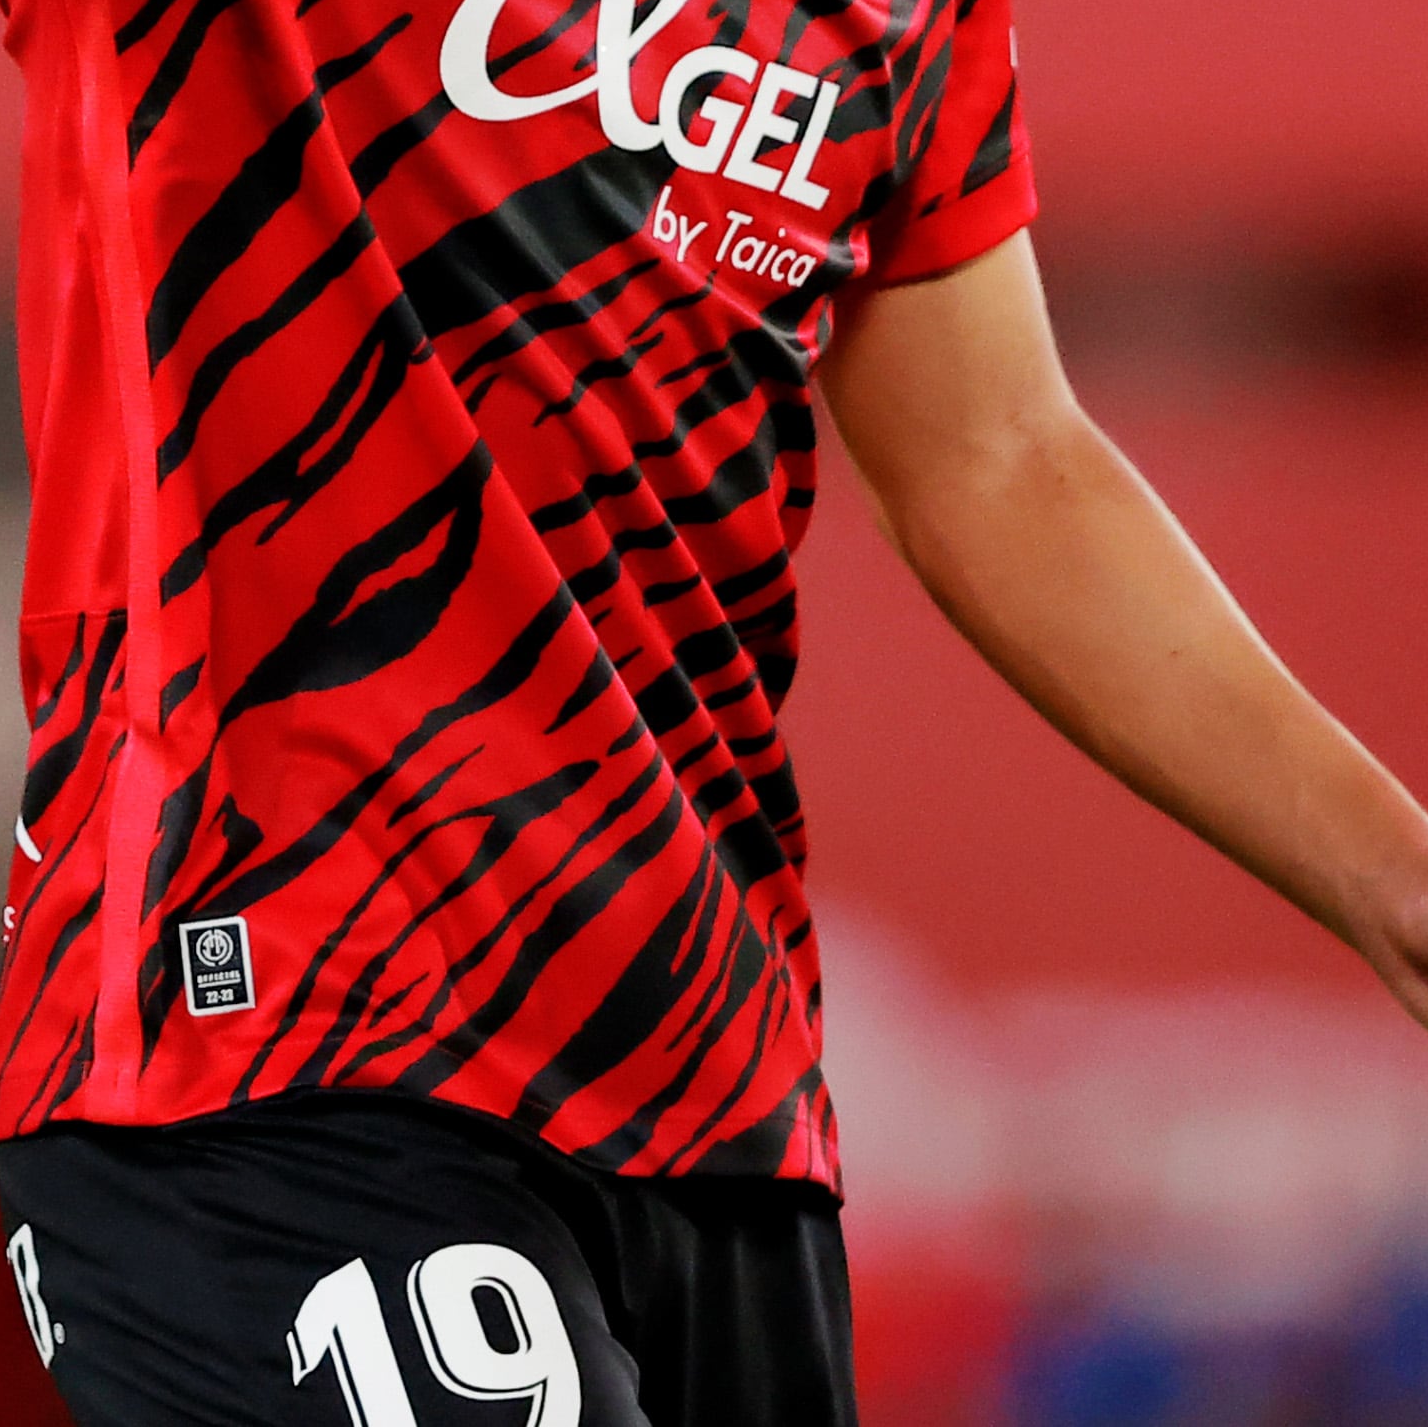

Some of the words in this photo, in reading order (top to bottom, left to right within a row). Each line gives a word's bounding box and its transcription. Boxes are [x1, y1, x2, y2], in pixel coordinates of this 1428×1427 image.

[652, 184, 709, 263] by
[715, 210, 817, 288] Taica
[286, 1243, 582, 1427] 19
